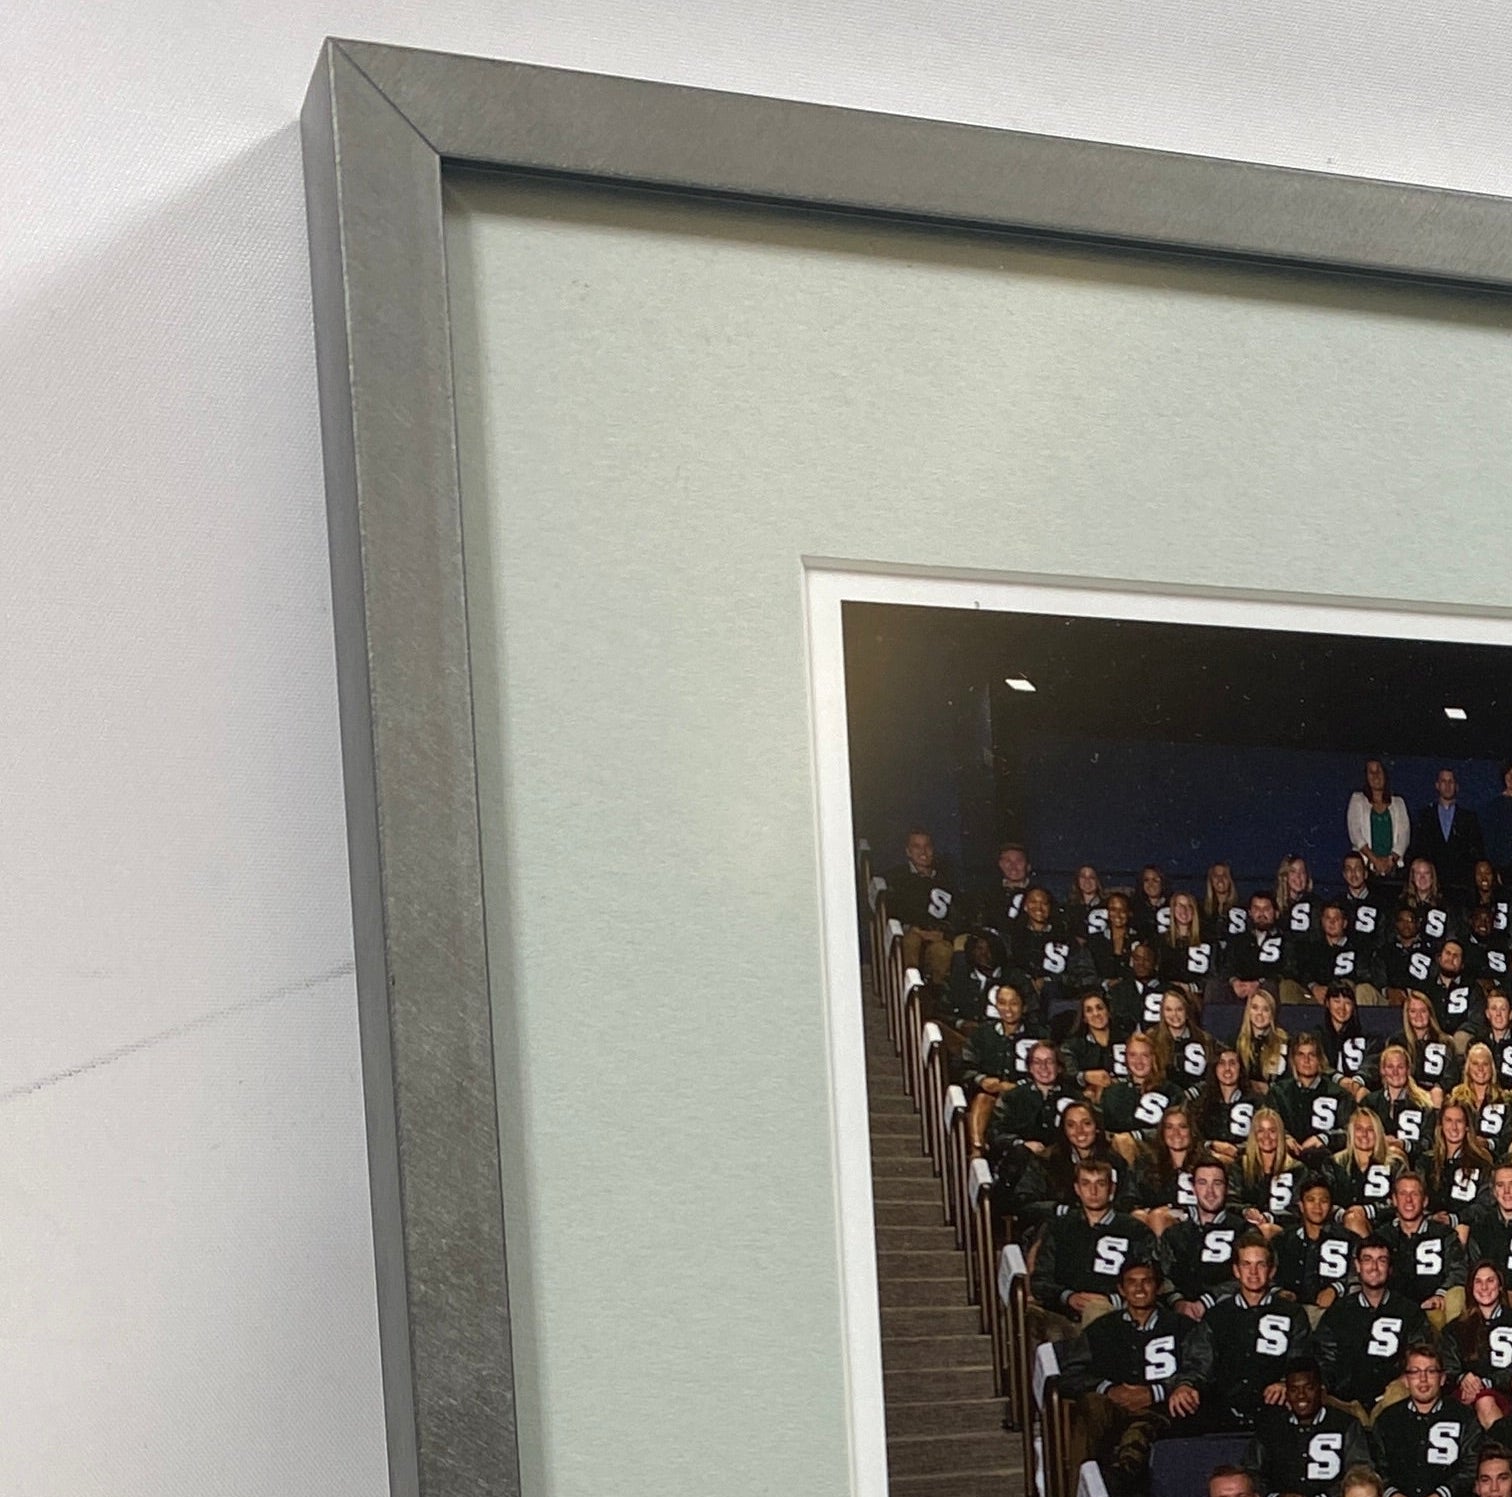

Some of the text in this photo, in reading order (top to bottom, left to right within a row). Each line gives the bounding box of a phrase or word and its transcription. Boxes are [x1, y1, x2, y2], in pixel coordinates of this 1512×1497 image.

[928, 888, 953, 918] S
[1291, 903, 1309, 930] S
[1088, 908, 1109, 933] S
[1229, 908, 1246, 933] S
[1356, 907, 1376, 932] S
[1426, 910, 1446, 937] S
[1044, 943, 1065, 973] S
[1188, 944, 1210, 973] S
[1259, 938, 1281, 961] S
[1335, 952, 1354, 974] S
[1488, 951, 1506, 972] S
[1410, 953, 1431, 979] S
[1448, 988, 1468, 1013] S
[1185, 1043, 1206, 1075] S
[1344, 1039, 1362, 1070] S
[1424, 1043, 1446, 1075] S
[1135, 1093, 1168, 1124] S
[1231, 1104, 1253, 1136] S
[1312, 1097, 1337, 1134] S
[1481, 1104, 1504, 1134] S
[1398, 1110, 1421, 1142] S
[1270, 1173, 1292, 1214] S
[1365, 1165, 1390, 1197] S
[1094, 1237, 1128, 1274] S
[1202, 1231, 1234, 1262] S
[1320, 1240, 1348, 1277] S
[1416, 1239, 1441, 1274] S
[1257, 1315, 1290, 1355] S
[1368, 1318, 1402, 1356] S
[1145, 1336, 1176, 1380] S
[1308, 1434, 1341, 1479] S
[1428, 1422, 1460, 1464] S
